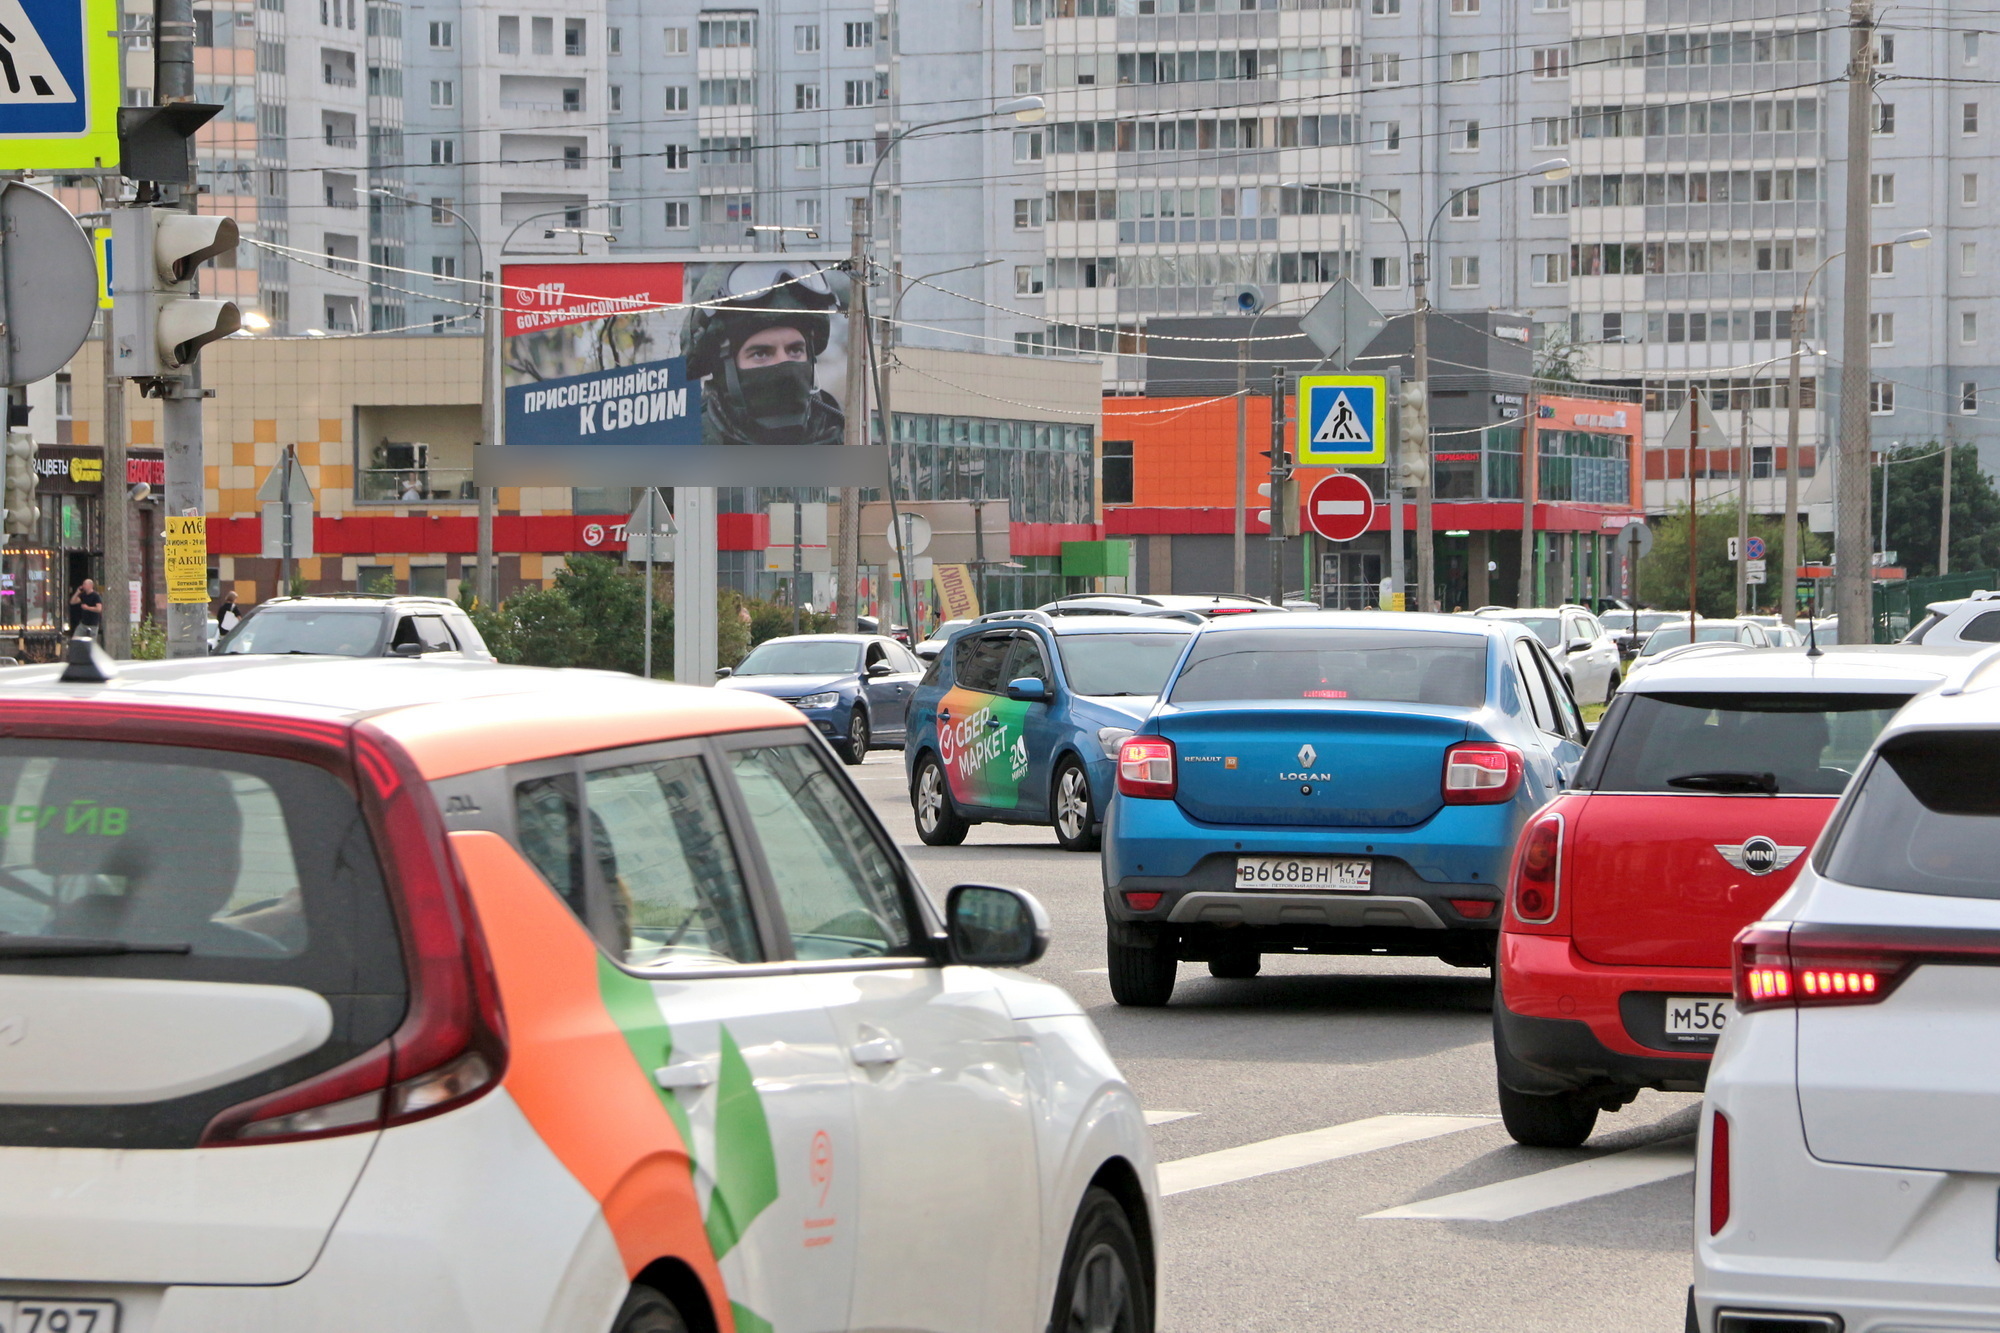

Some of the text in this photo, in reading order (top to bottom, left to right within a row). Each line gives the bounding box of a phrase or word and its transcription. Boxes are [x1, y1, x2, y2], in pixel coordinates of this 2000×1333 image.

[537, 283, 565, 306] 117
[516, 292, 650, 329] GOV.SPB.RU/CONTRACT
[524, 367, 669, 414] ПРИСОЕДИНЯЙСЯ
[580, 388, 688, 436] К СВОИМ
[955, 707, 990, 748] СБЕР
[958, 725, 1008, 780] МАРКЕТ
[1279, 772, 1332, 782] LOGAN
[1334, 862, 1367, 878] 147
[1745, 850, 1773, 861] MINI
[22, 1307, 99, 1333] 797
